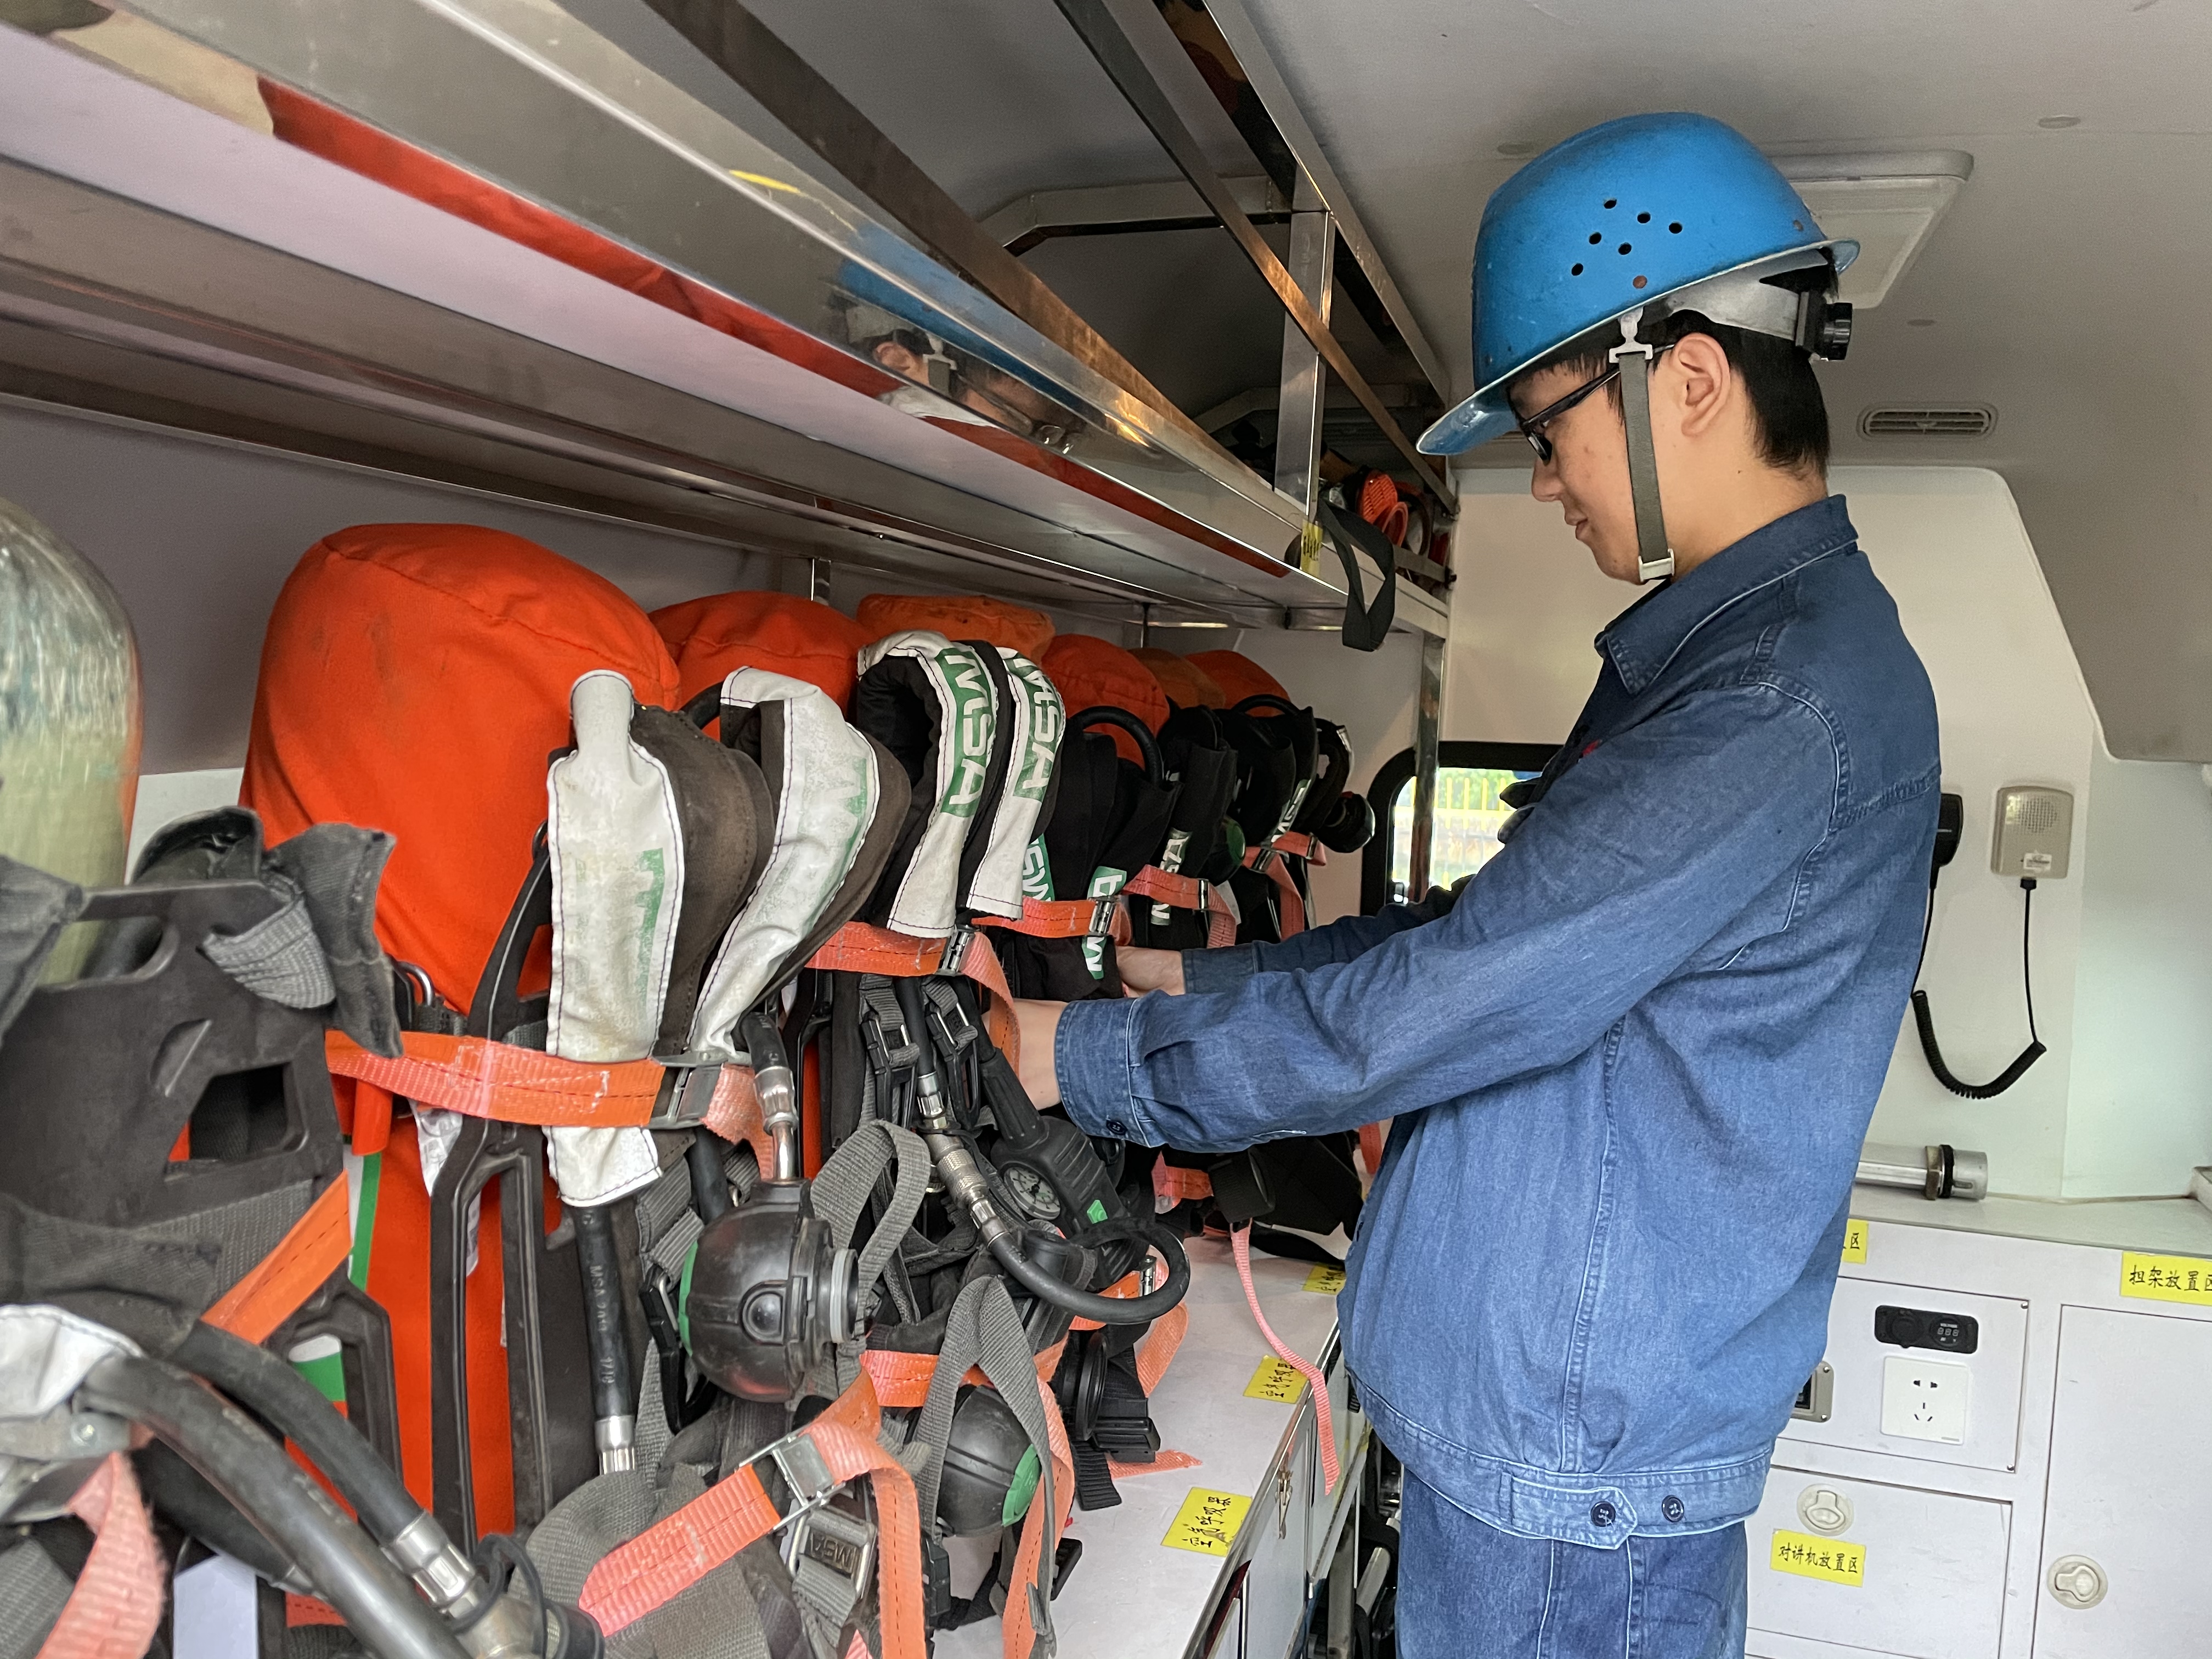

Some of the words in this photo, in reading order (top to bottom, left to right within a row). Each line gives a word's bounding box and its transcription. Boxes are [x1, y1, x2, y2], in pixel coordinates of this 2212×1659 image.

[944, 655, 992, 805] MSA
[1013, 658, 1059, 789] MSA
[1182, 1497, 1231, 1548] 空气呼吸器
[1779, 1542, 1858, 1573] 对讲机放置区
